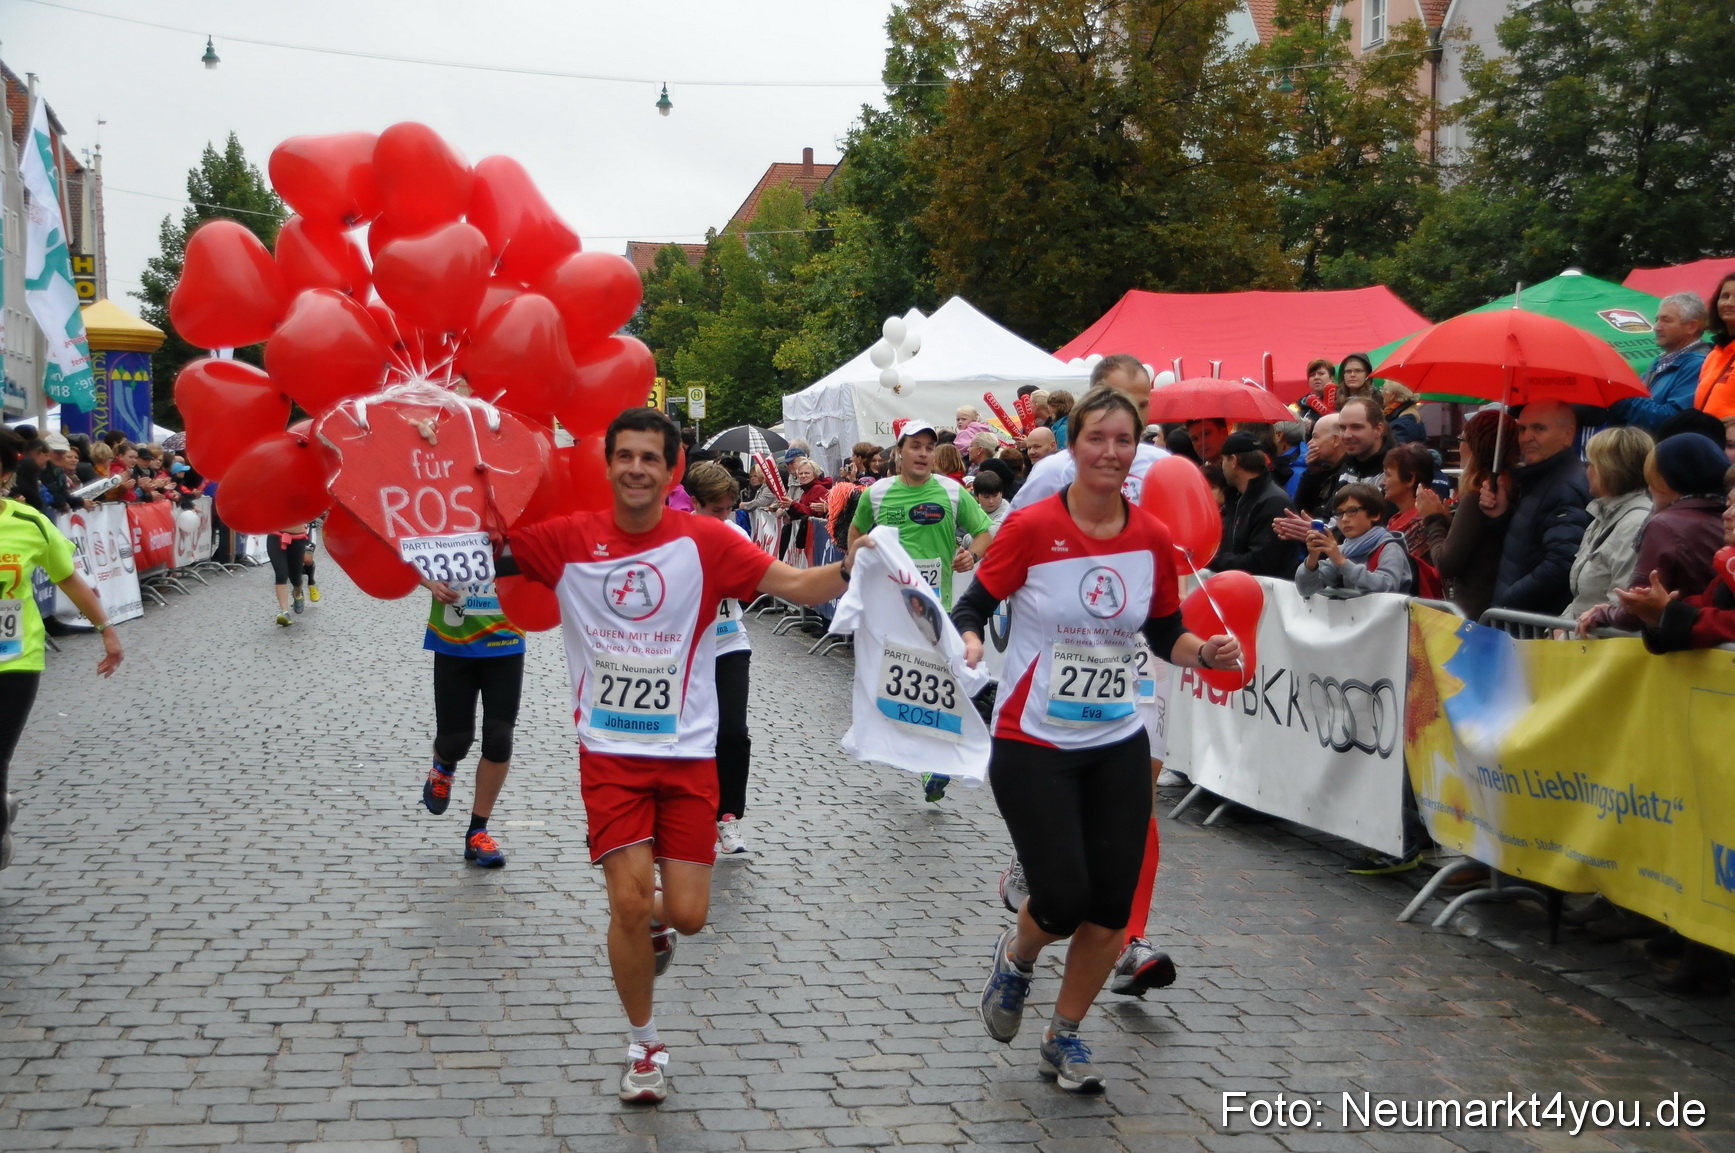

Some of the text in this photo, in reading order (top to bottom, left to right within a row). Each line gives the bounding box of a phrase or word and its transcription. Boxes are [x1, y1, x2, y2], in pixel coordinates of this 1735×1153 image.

[412, 448, 454, 479] für
[403, 538, 478, 551] PARTL Neumarkt
[415, 550, 491, 582] 3333
[466, 598, 491, 608] Oliver
[0, 614, 16, 638] 9
[884, 648, 912, 664] PARTL
[1054, 651, 1120, 664] PARTL Neumarkt
[1134, 650, 1149, 677] 2
[595, 659, 665, 674] PARTL Neumarkt
[599, 674, 671, 710] 2723
[885, 664, 956, 710] 3333
[1058, 665, 1126, 699] 2725
[604, 714, 660, 731] Johannes
[1081, 706, 1102, 719] Eva
